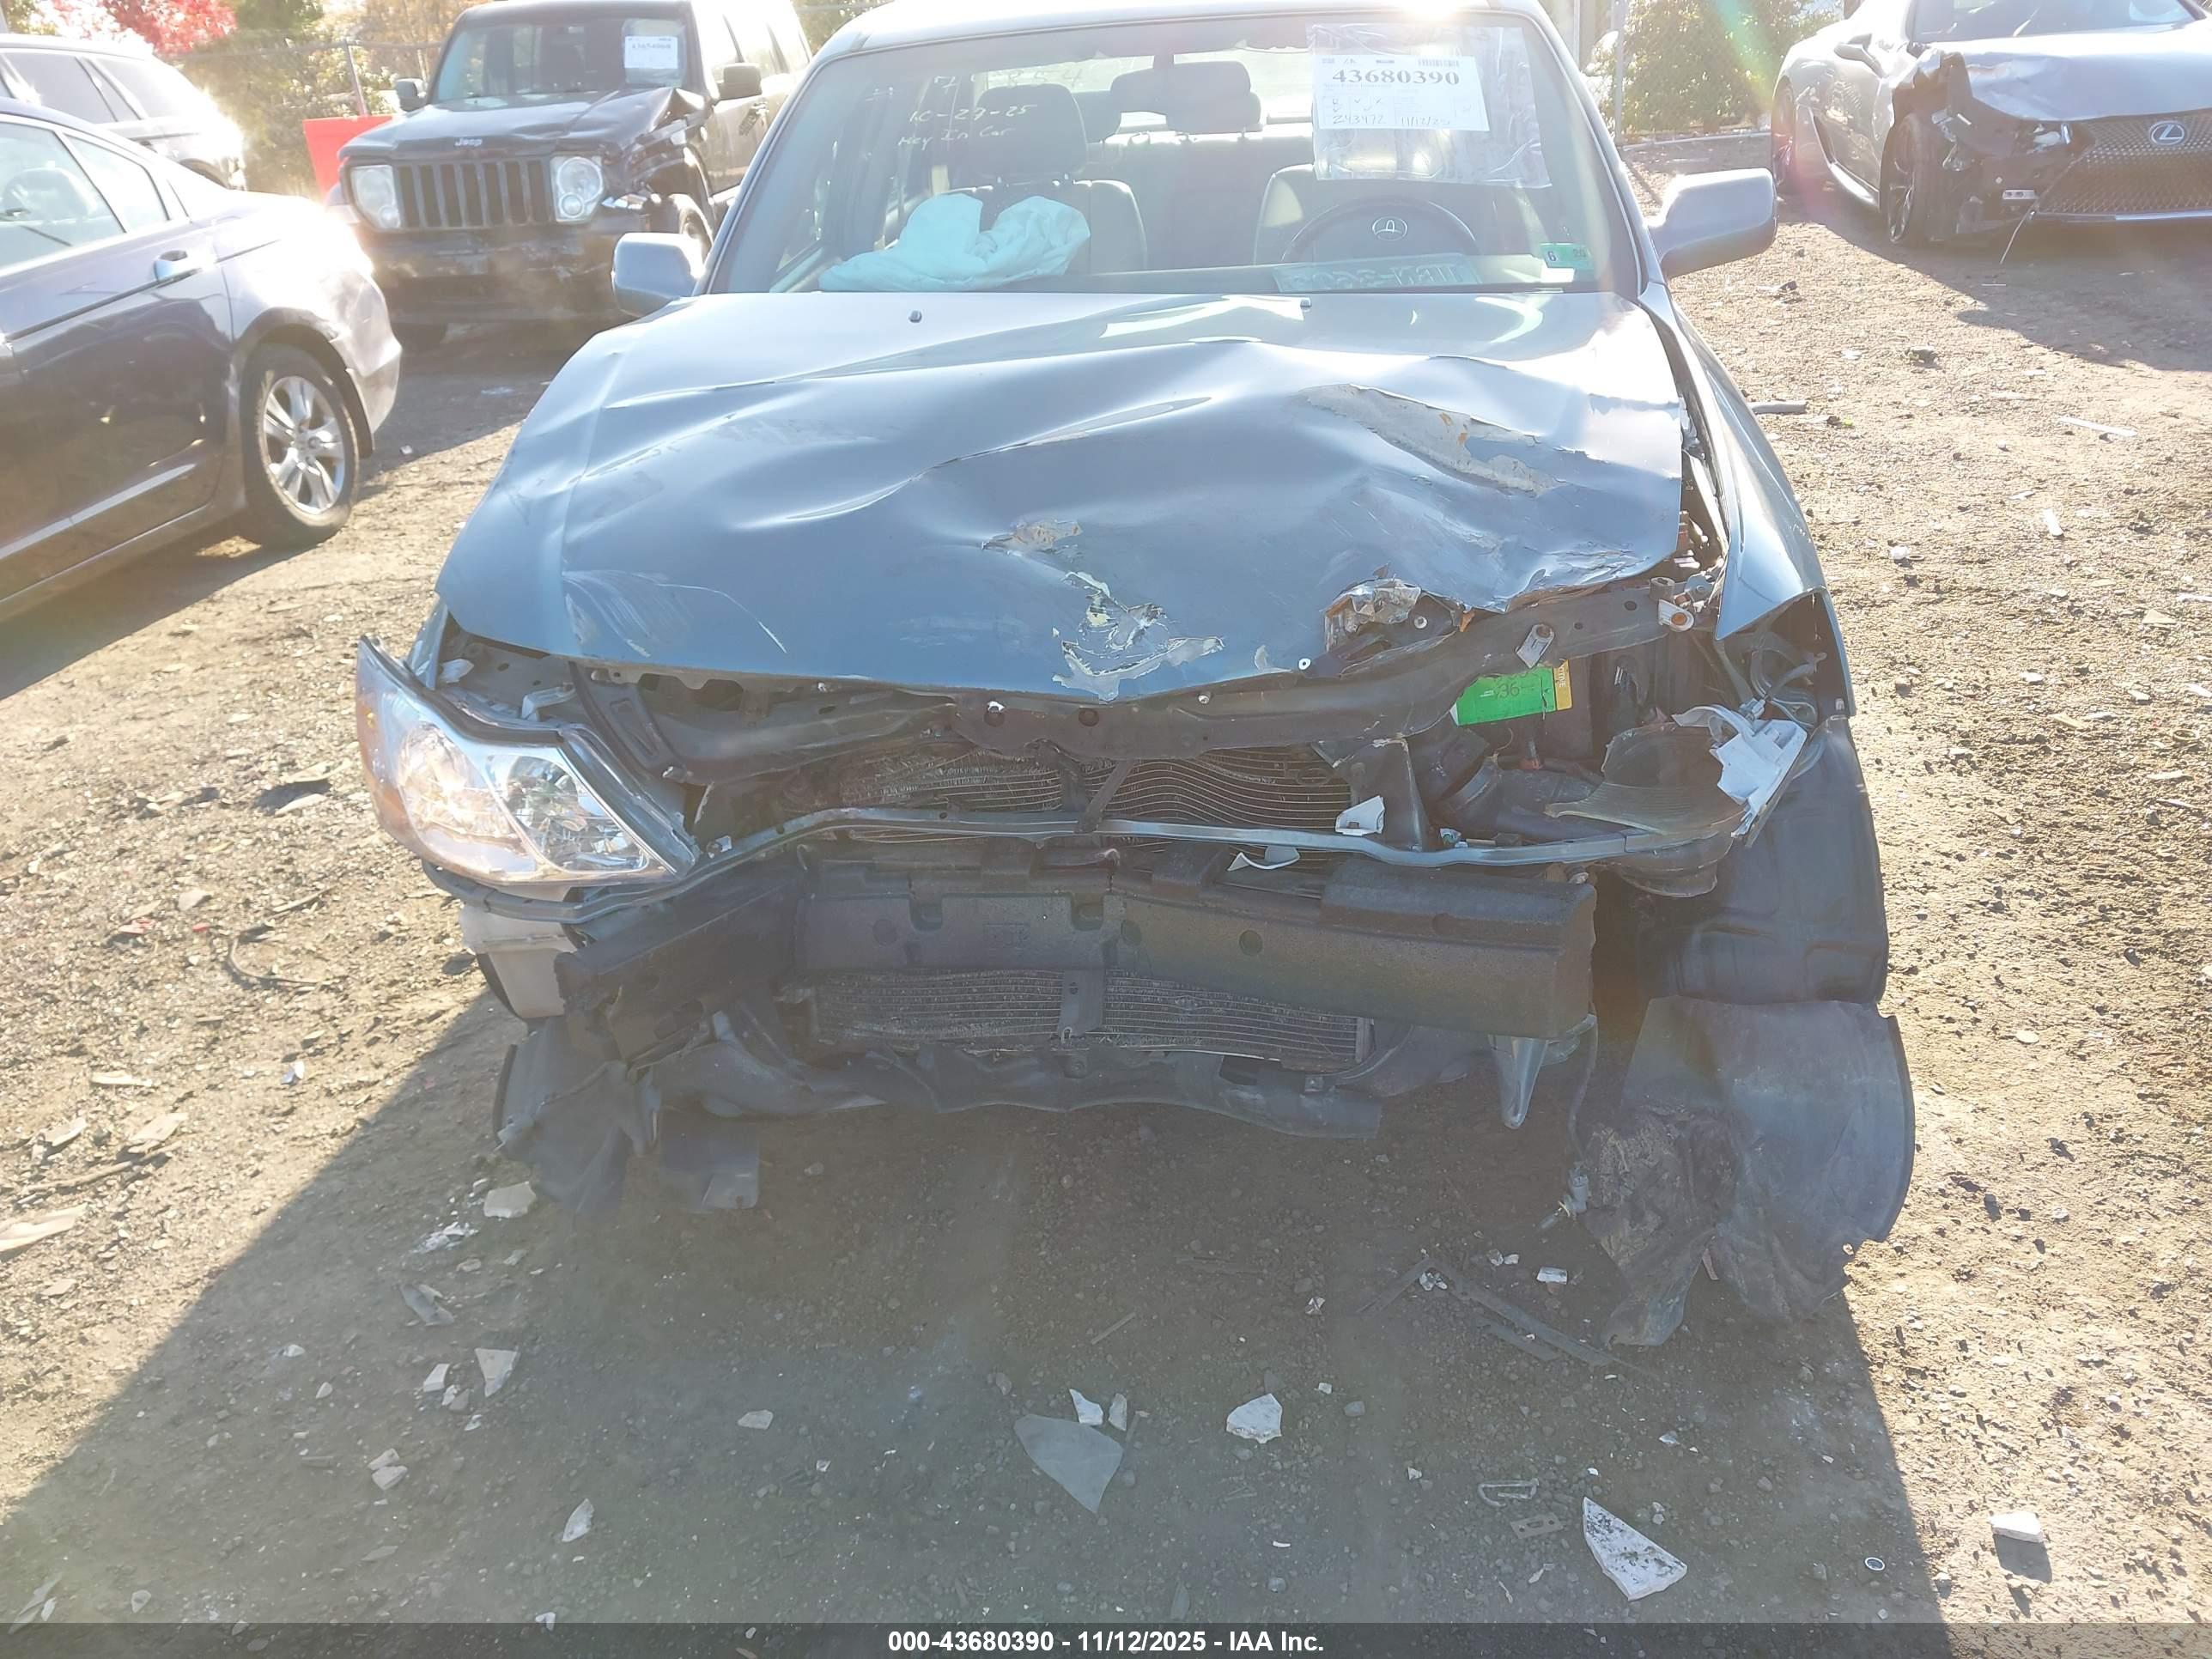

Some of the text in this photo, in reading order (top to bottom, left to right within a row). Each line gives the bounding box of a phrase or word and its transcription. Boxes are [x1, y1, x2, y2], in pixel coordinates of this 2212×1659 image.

[1332, 68, 1461, 86] 43680390
[454, 137, 483, 147] Jeep
[1547, 250, 1557, 262] 6
